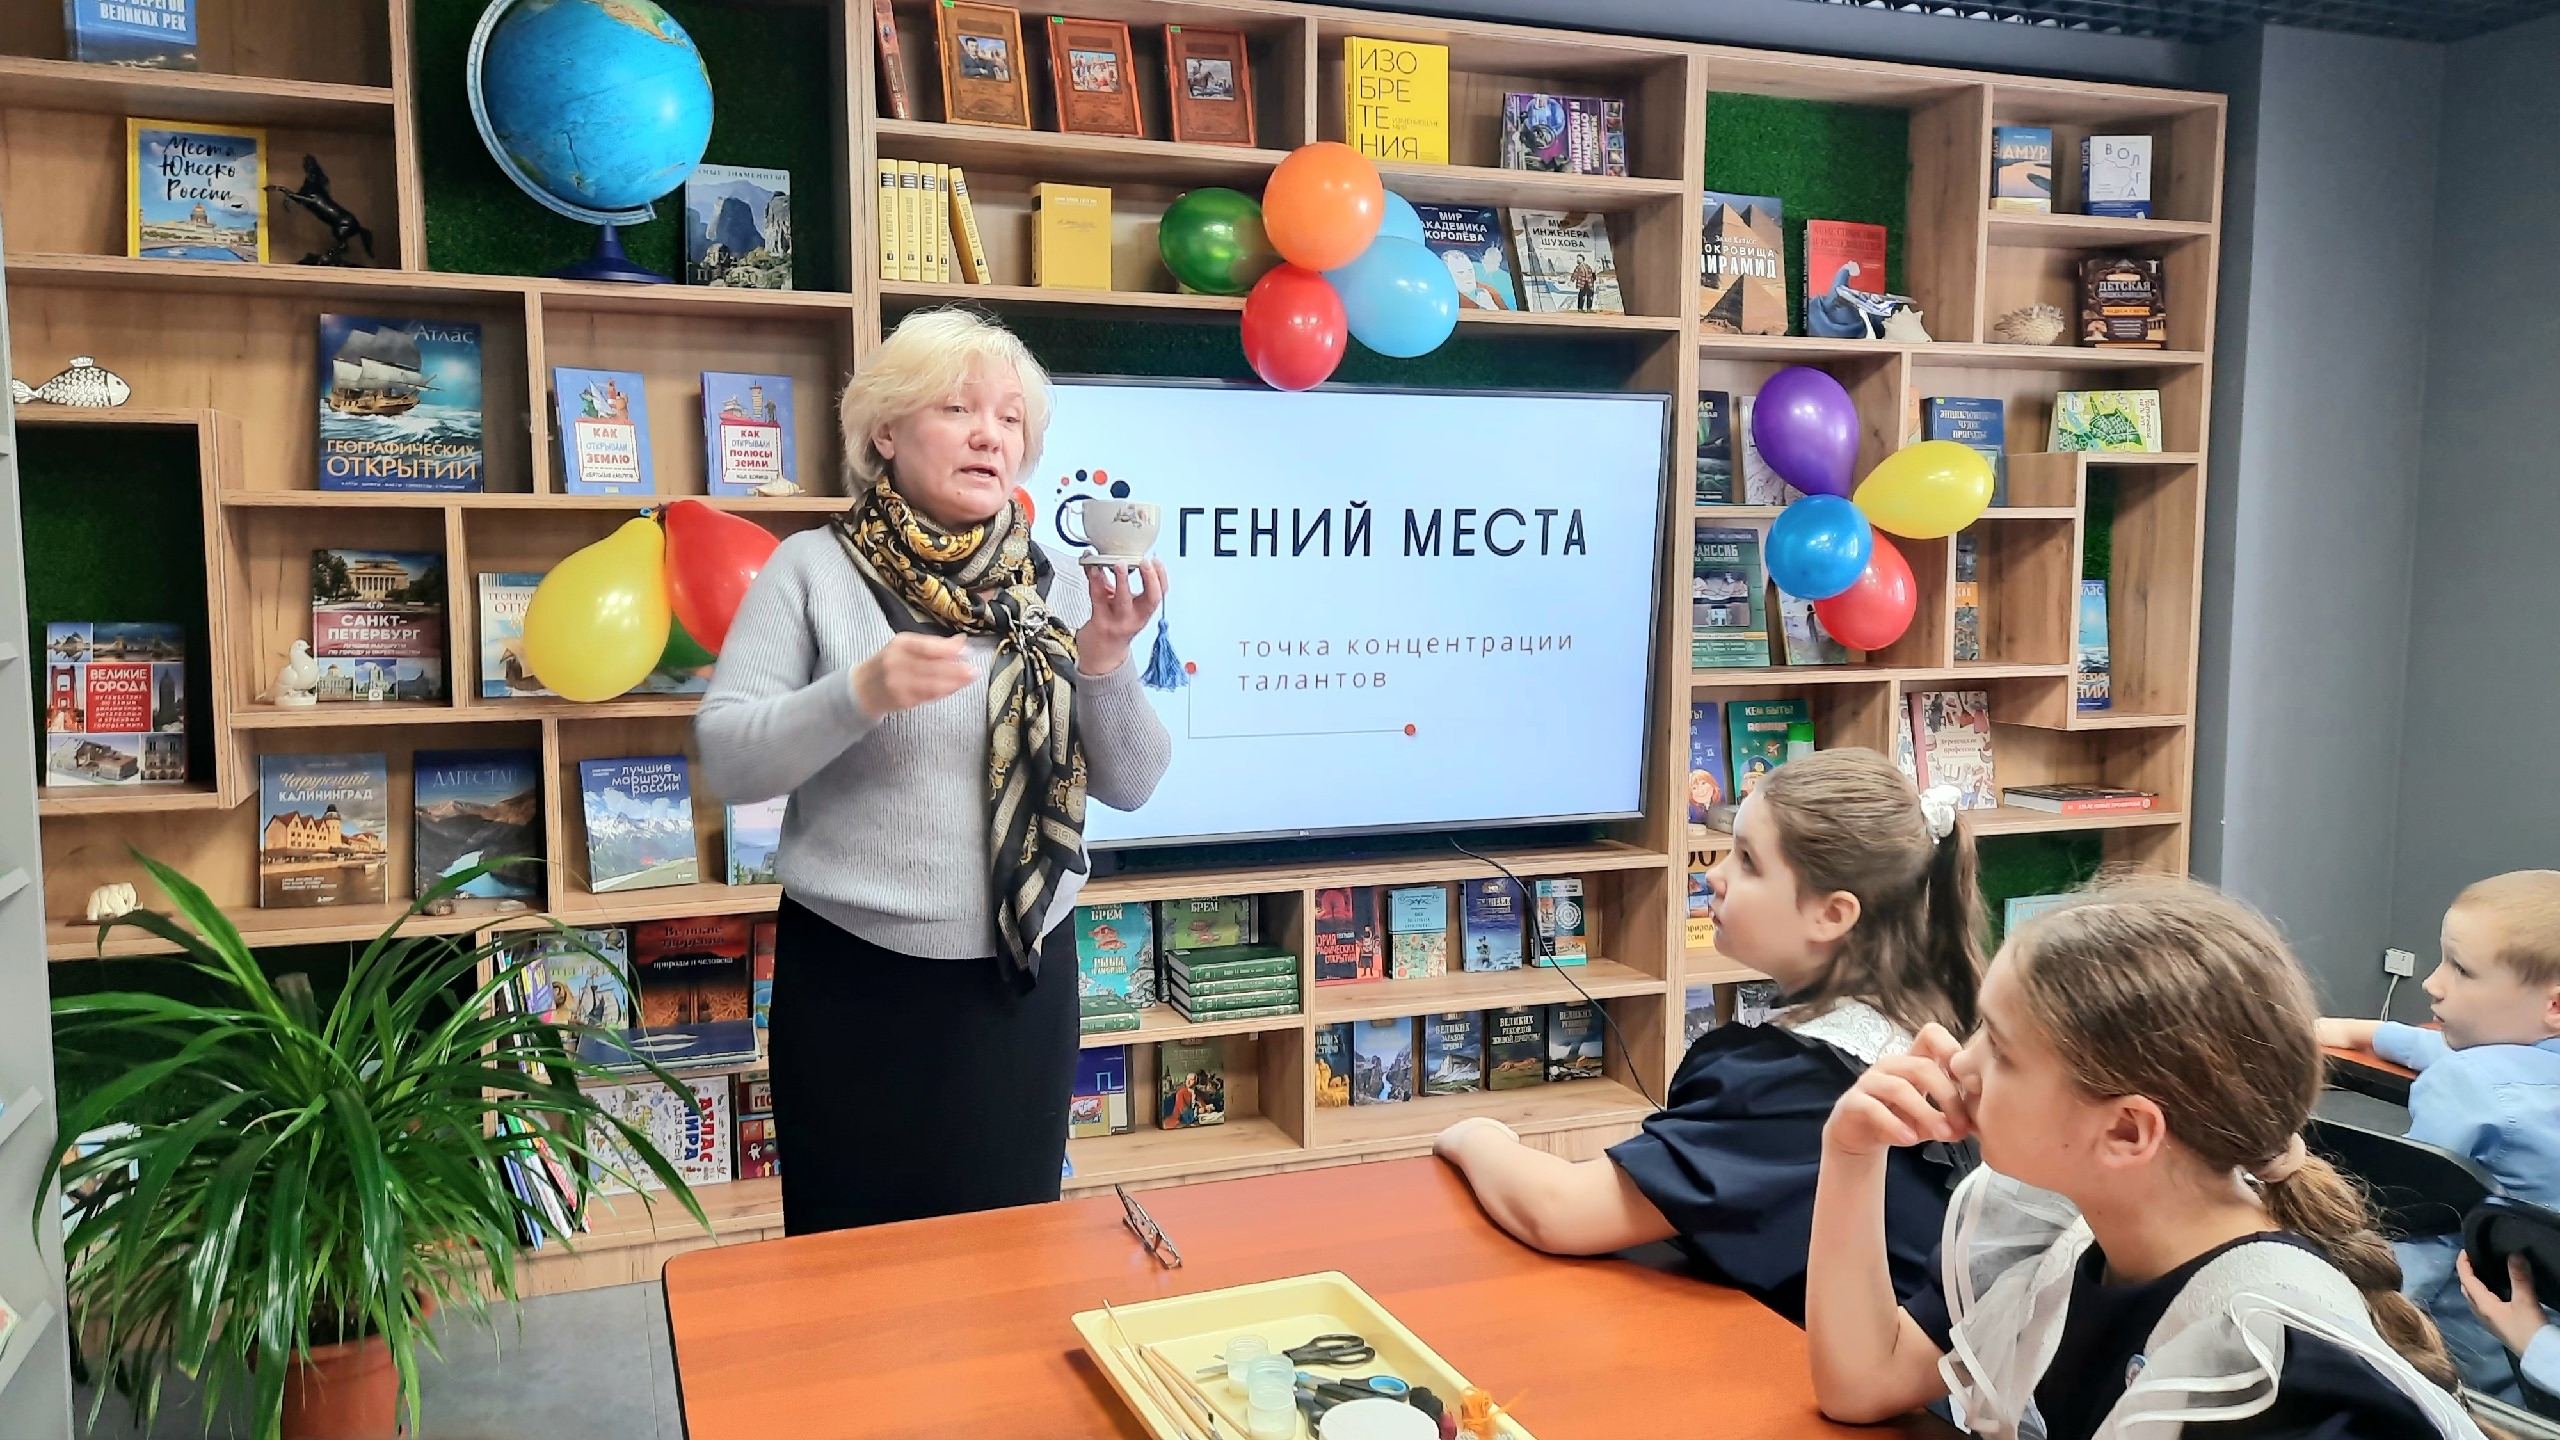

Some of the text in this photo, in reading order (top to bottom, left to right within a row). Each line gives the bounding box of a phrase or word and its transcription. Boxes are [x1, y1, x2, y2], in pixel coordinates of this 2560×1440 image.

[100, 3, 187, 32] ВЕЛИКИХ РЕК
[1360, 46, 1418, 75] ИЗО
[1360, 75, 1412, 103] БРЕ
[1357, 103, 1390, 130] ТЕ
[1569, 101, 1582, 174] И ИЗОБРЕТЕНИ
[1580, 112, 1592, 171] ОТКРЫТИЯ
[164, 136, 236, 158] Места
[1360, 133, 1418, 160] НИЯ
[2002, 144, 2049, 160] АМУР
[159, 154, 236, 179] Юнеско
[167, 178, 233, 200] России
[1438, 211, 1463, 221] МИР
[1425, 230, 1486, 243] КОРОЛЁВА
[1532, 227, 1590, 239] ИНЖЕНЕРА
[1541, 237, 1586, 249] ШУХОВА
[1704, 243, 1775, 259] ОКРОВИЩА
[2099, 281, 2151, 291] ДЕТСКАЯ
[414, 325, 474, 344] Атлас
[592, 427, 618, 439] КАК
[740, 430, 761, 438] КАК
[327, 439, 475, 457] ГЕОГРАФИЧЕСКИХ
[729, 449, 773, 459] ПОЛЮСЫ
[586, 453, 631, 464] ЗЕМЛЮ
[734, 459, 769, 468] ЗЕМЛИ
[1178, 500, 1587, 558] ГЕНИЙ МЕСТА
[1696, 544, 1739, 557] АНССИБ
[488, 592, 533, 601] ГЕОГРАФ
[2081, 585, 2105, 597] тлас
[494, 602, 526, 614] ОТК
[340, 614, 408, 628] САНКТ-
[327, 627, 421, 641] ПЕТЕРБУРГ
[1239, 631, 1573, 659] точка концентрации
[90, 668, 148, 681] ВЕЛИКИЕ
[1238, 671, 1388, 692] талантов
[90, 680, 148, 693] ГОРОДА
[1745, 706, 1764, 716] КЕМ
[278, 788, 374, 802] КАЛИНИНГРАД
[1190, 901, 1219, 913] БРЕМ
[1091, 909, 1123, 921] БРЕМ
[1316, 933, 1337, 947] ОРИЯ
[1499, 1015, 1534, 1028] ВЕЛИКИХ
[698, 1096, 715, 1163] АТЛАС
